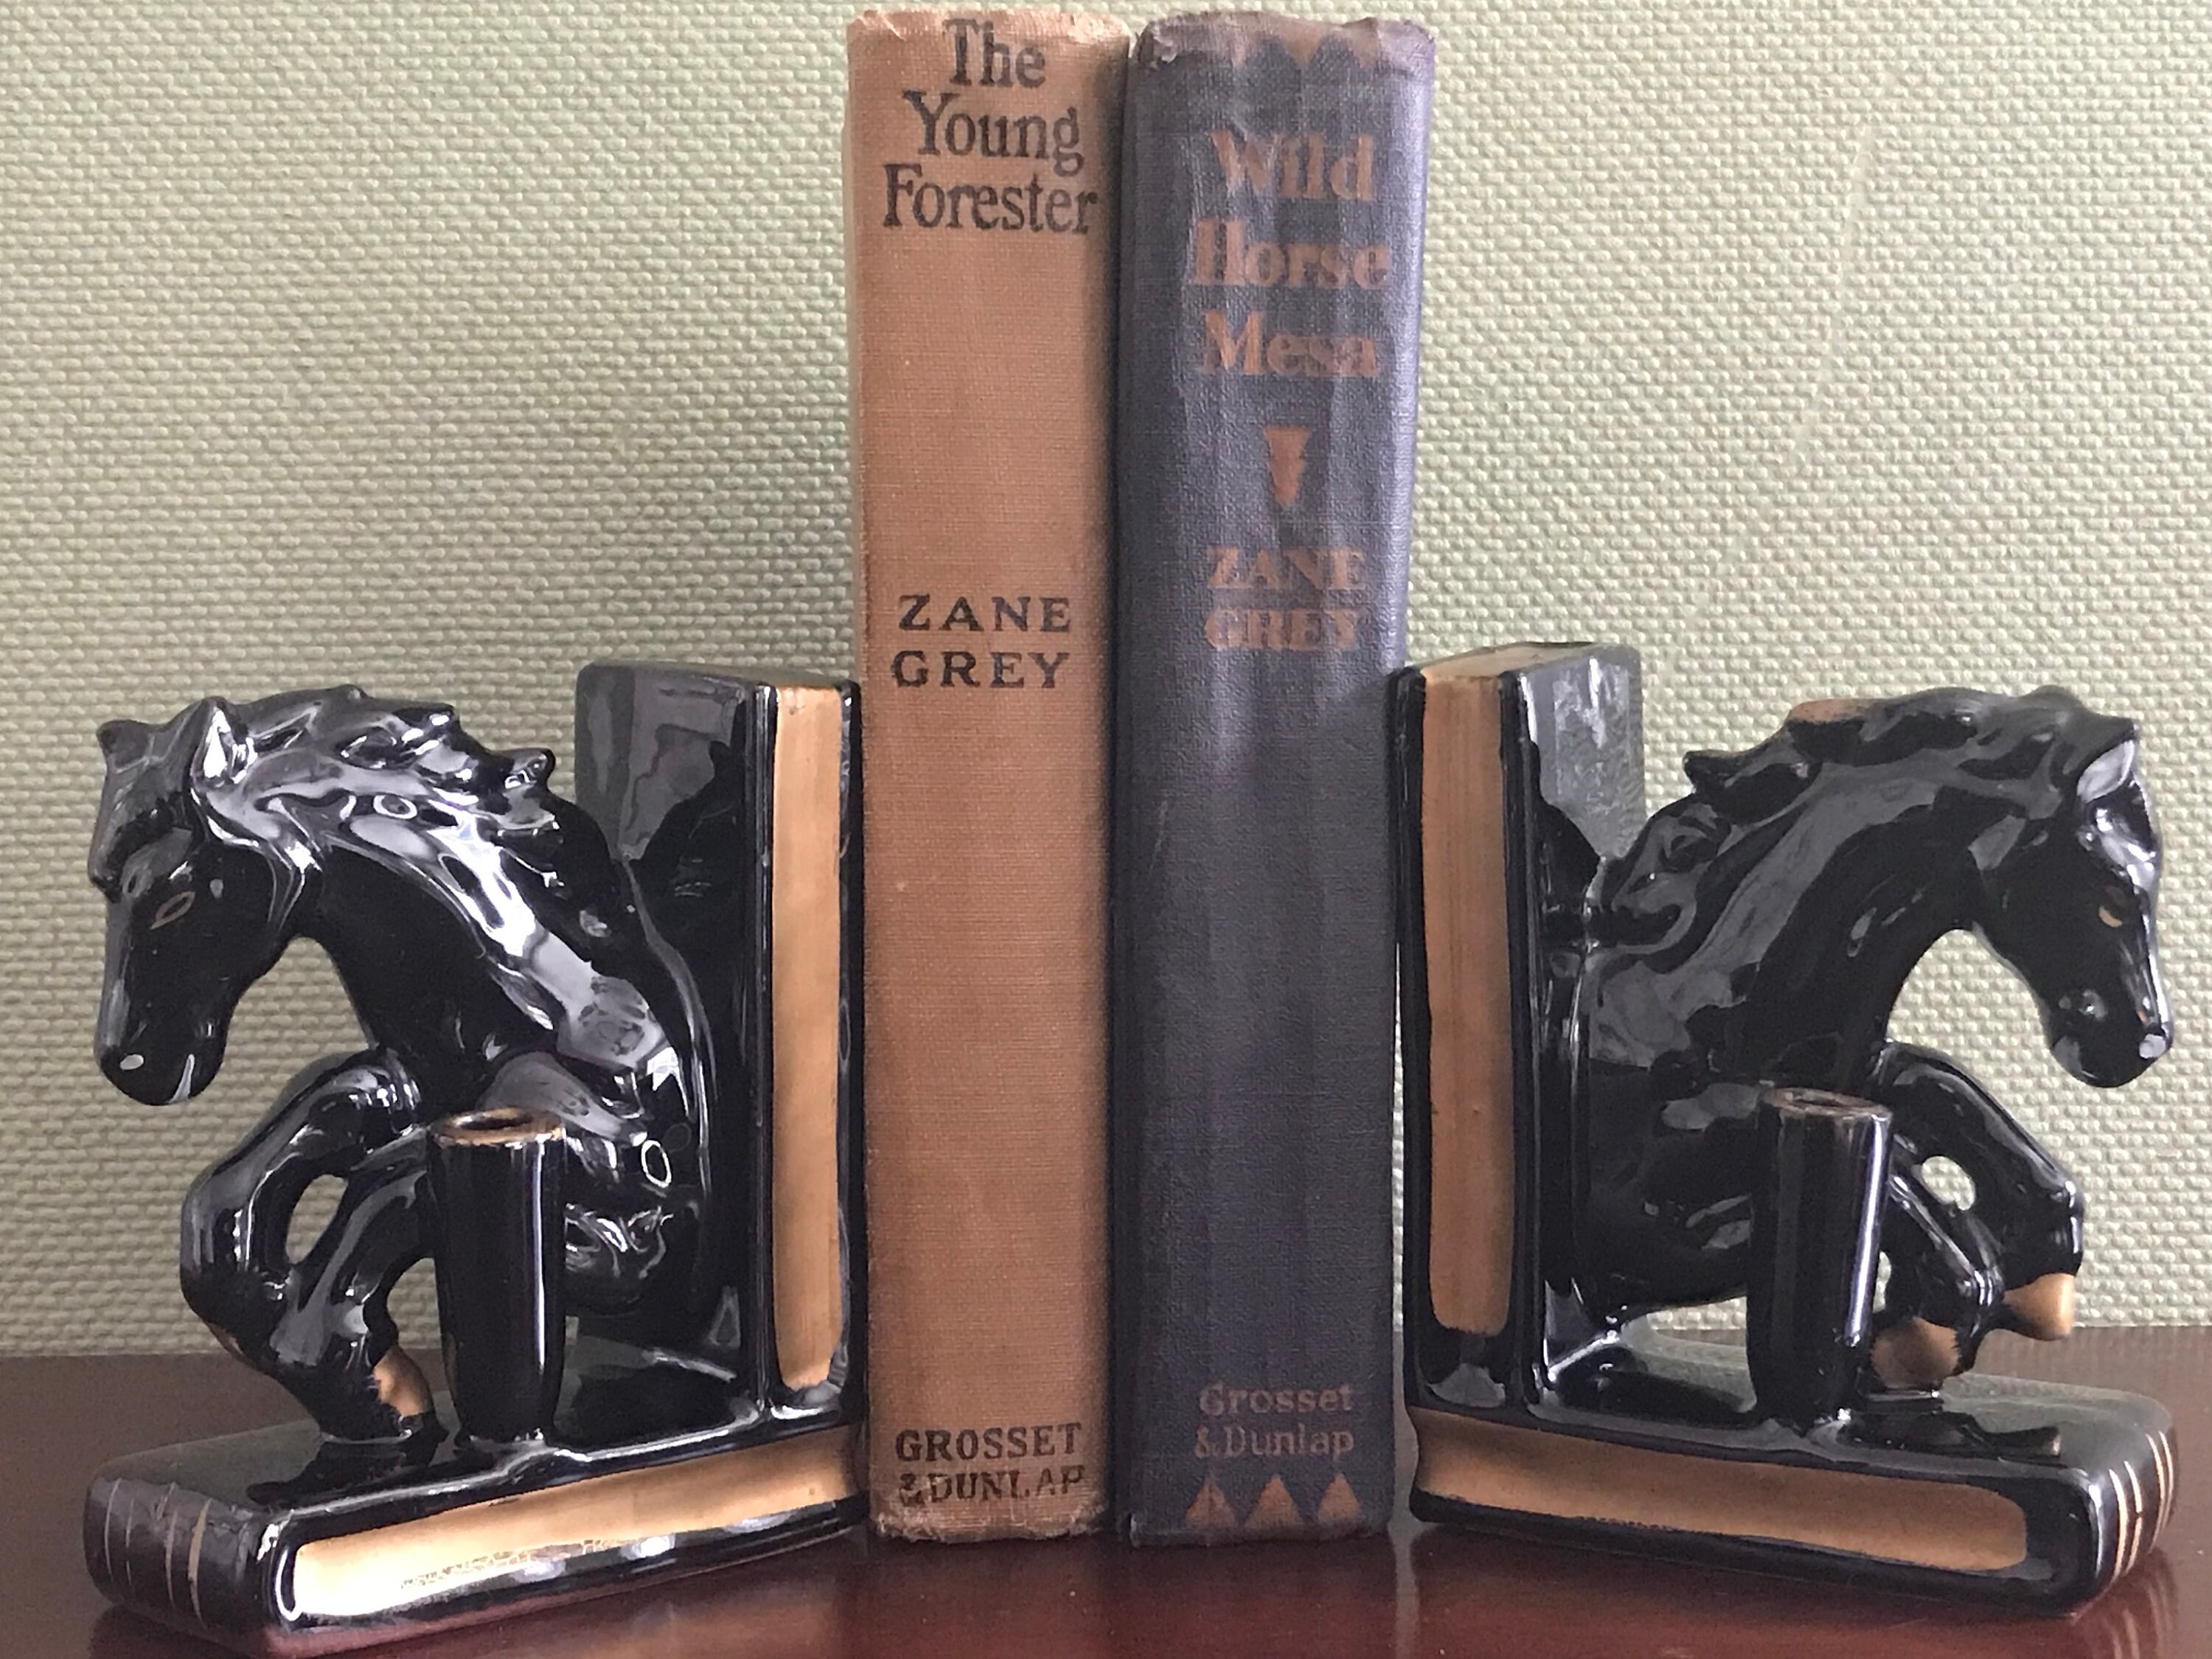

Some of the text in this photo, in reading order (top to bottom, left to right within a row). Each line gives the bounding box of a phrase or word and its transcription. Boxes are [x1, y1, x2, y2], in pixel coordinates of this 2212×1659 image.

[942, 18, 1046, 88] The
[901, 89, 1085, 178] Young
[1206, 127, 1376, 202] Wild
[883, 163, 1098, 234] Forester
[1193, 217, 1392, 290] Horse
[1200, 308, 1380, 378] Mesa
[1206, 546, 1365, 591] ZANE
[898, 593, 1071, 632] ZANE
[1204, 607, 1364, 651] GREY
[891, 650, 1071, 689] GREY
[1199, 1381, 1354, 1416] Grosset
[894, 1422, 1082, 1462] GROSSET
